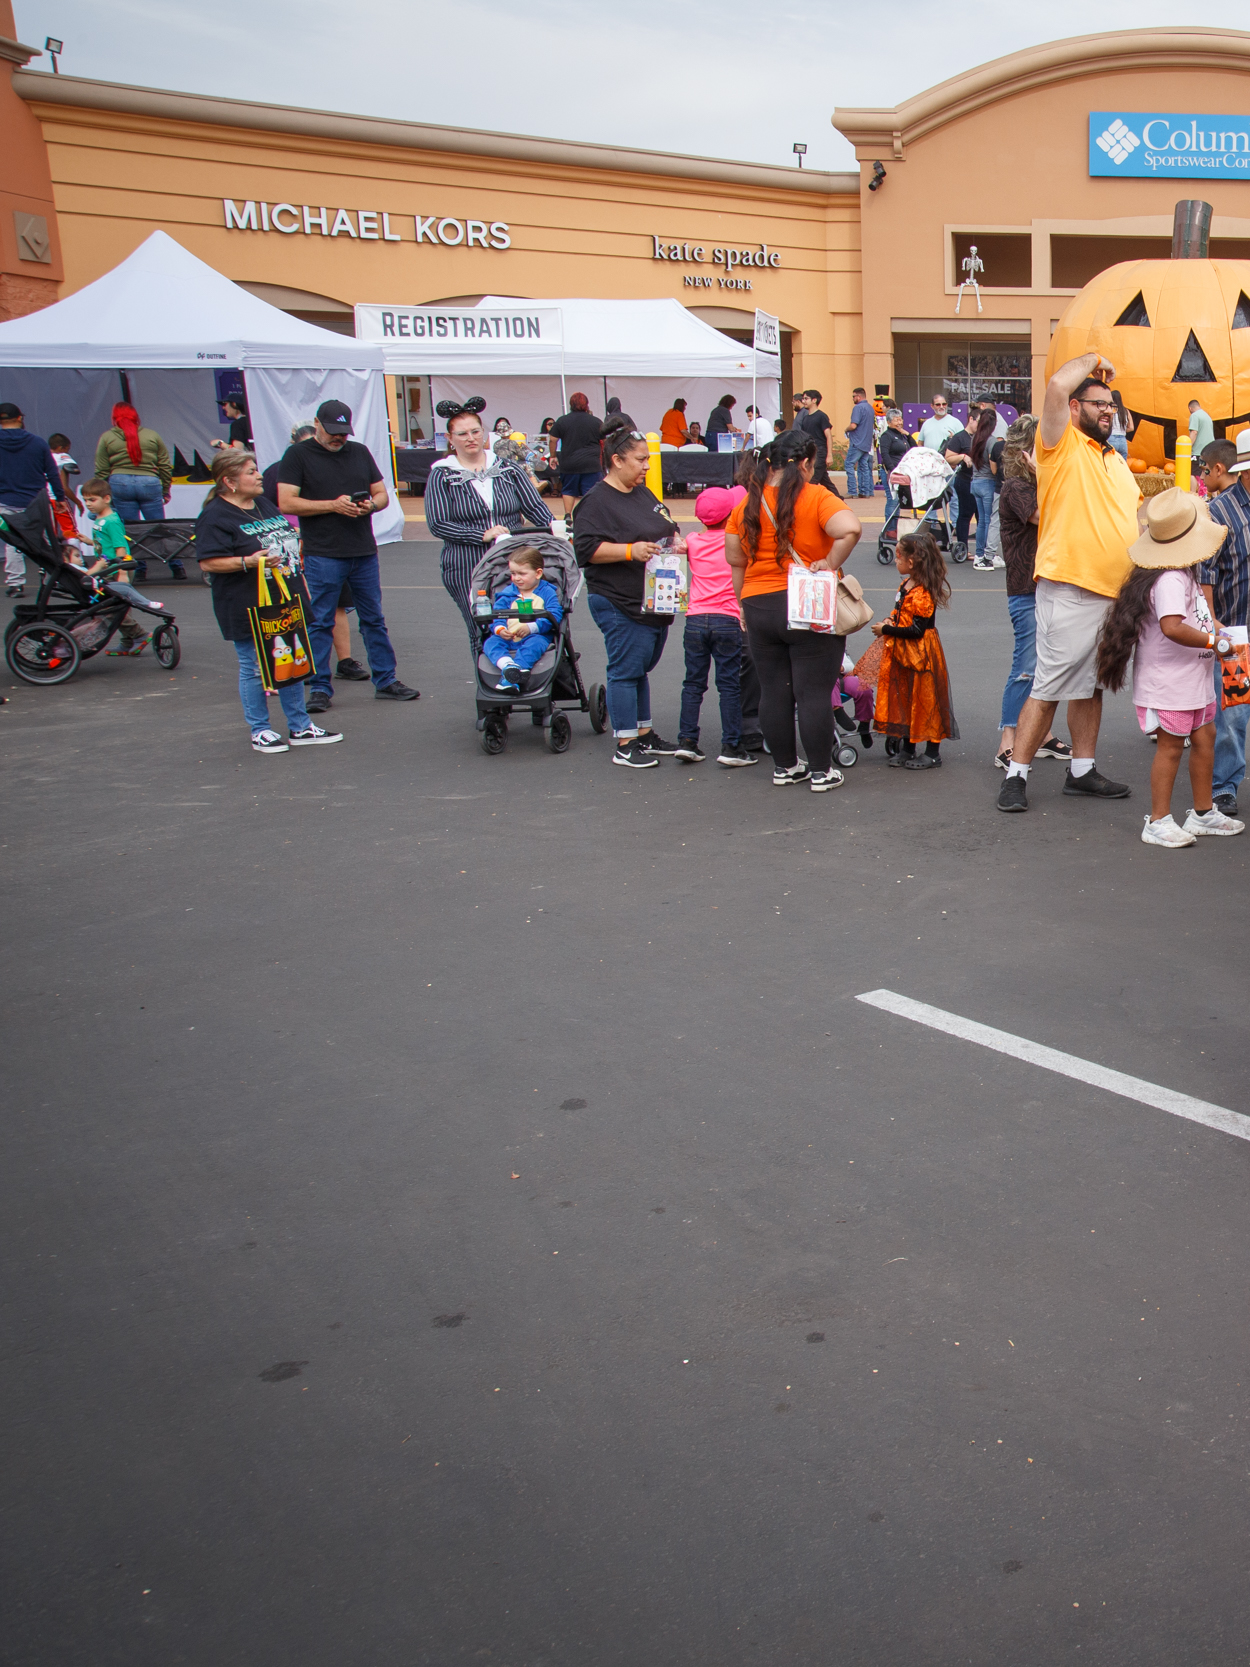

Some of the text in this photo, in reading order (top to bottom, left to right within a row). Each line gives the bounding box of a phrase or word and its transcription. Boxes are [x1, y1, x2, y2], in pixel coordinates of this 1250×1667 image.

[1144, 152, 1222, 171] Sportswear
[223, 198, 512, 249] MICHAEL KORS
[652, 235, 782, 271] kate spade
[683, 275, 754, 290] NEW YORK
[381, 312, 541, 338] REGISTRATION
[951, 382, 1012, 394] FALL SALE
[260, 619, 285, 633] TRICK
